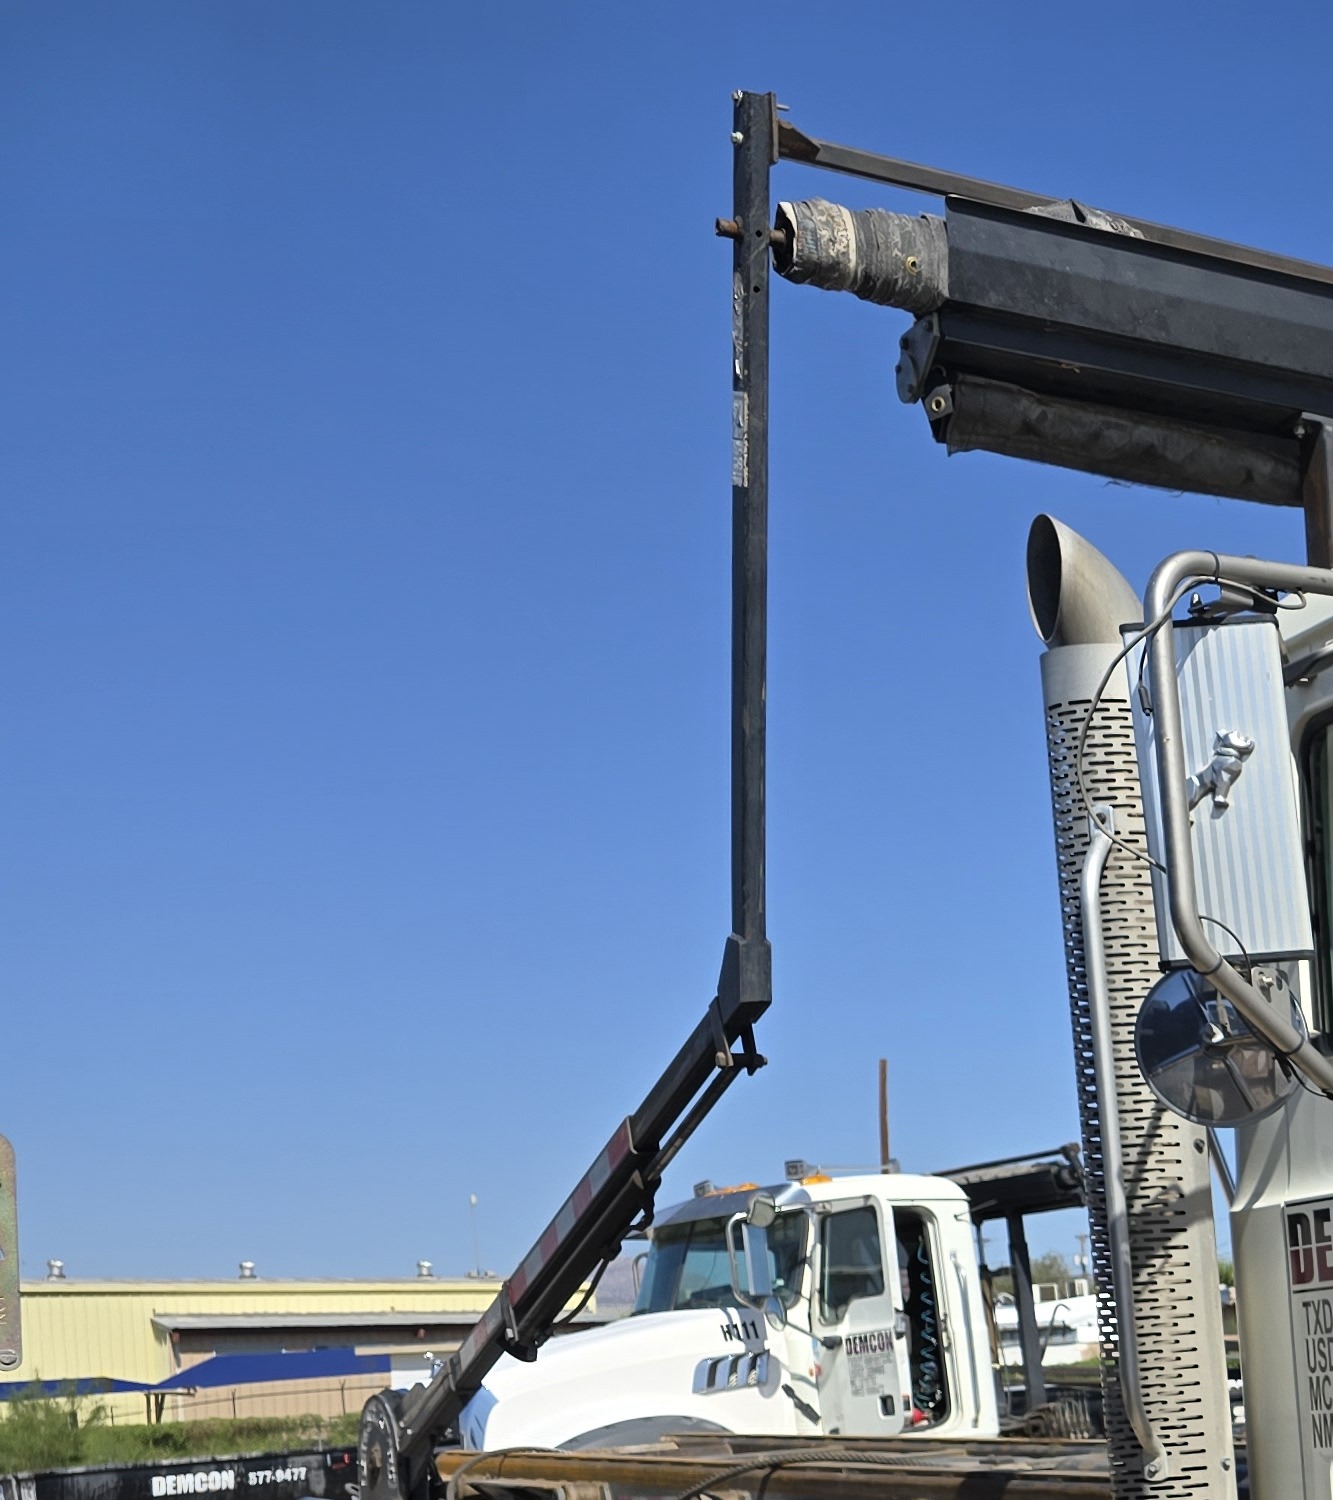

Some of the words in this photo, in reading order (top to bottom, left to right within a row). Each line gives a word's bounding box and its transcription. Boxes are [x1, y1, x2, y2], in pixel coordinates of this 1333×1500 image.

[845, 1330, 894, 1356] DEMCON
[1309, 1375, 1333, 1410] MC
[151, 1469, 235, 1497] DEMCON
